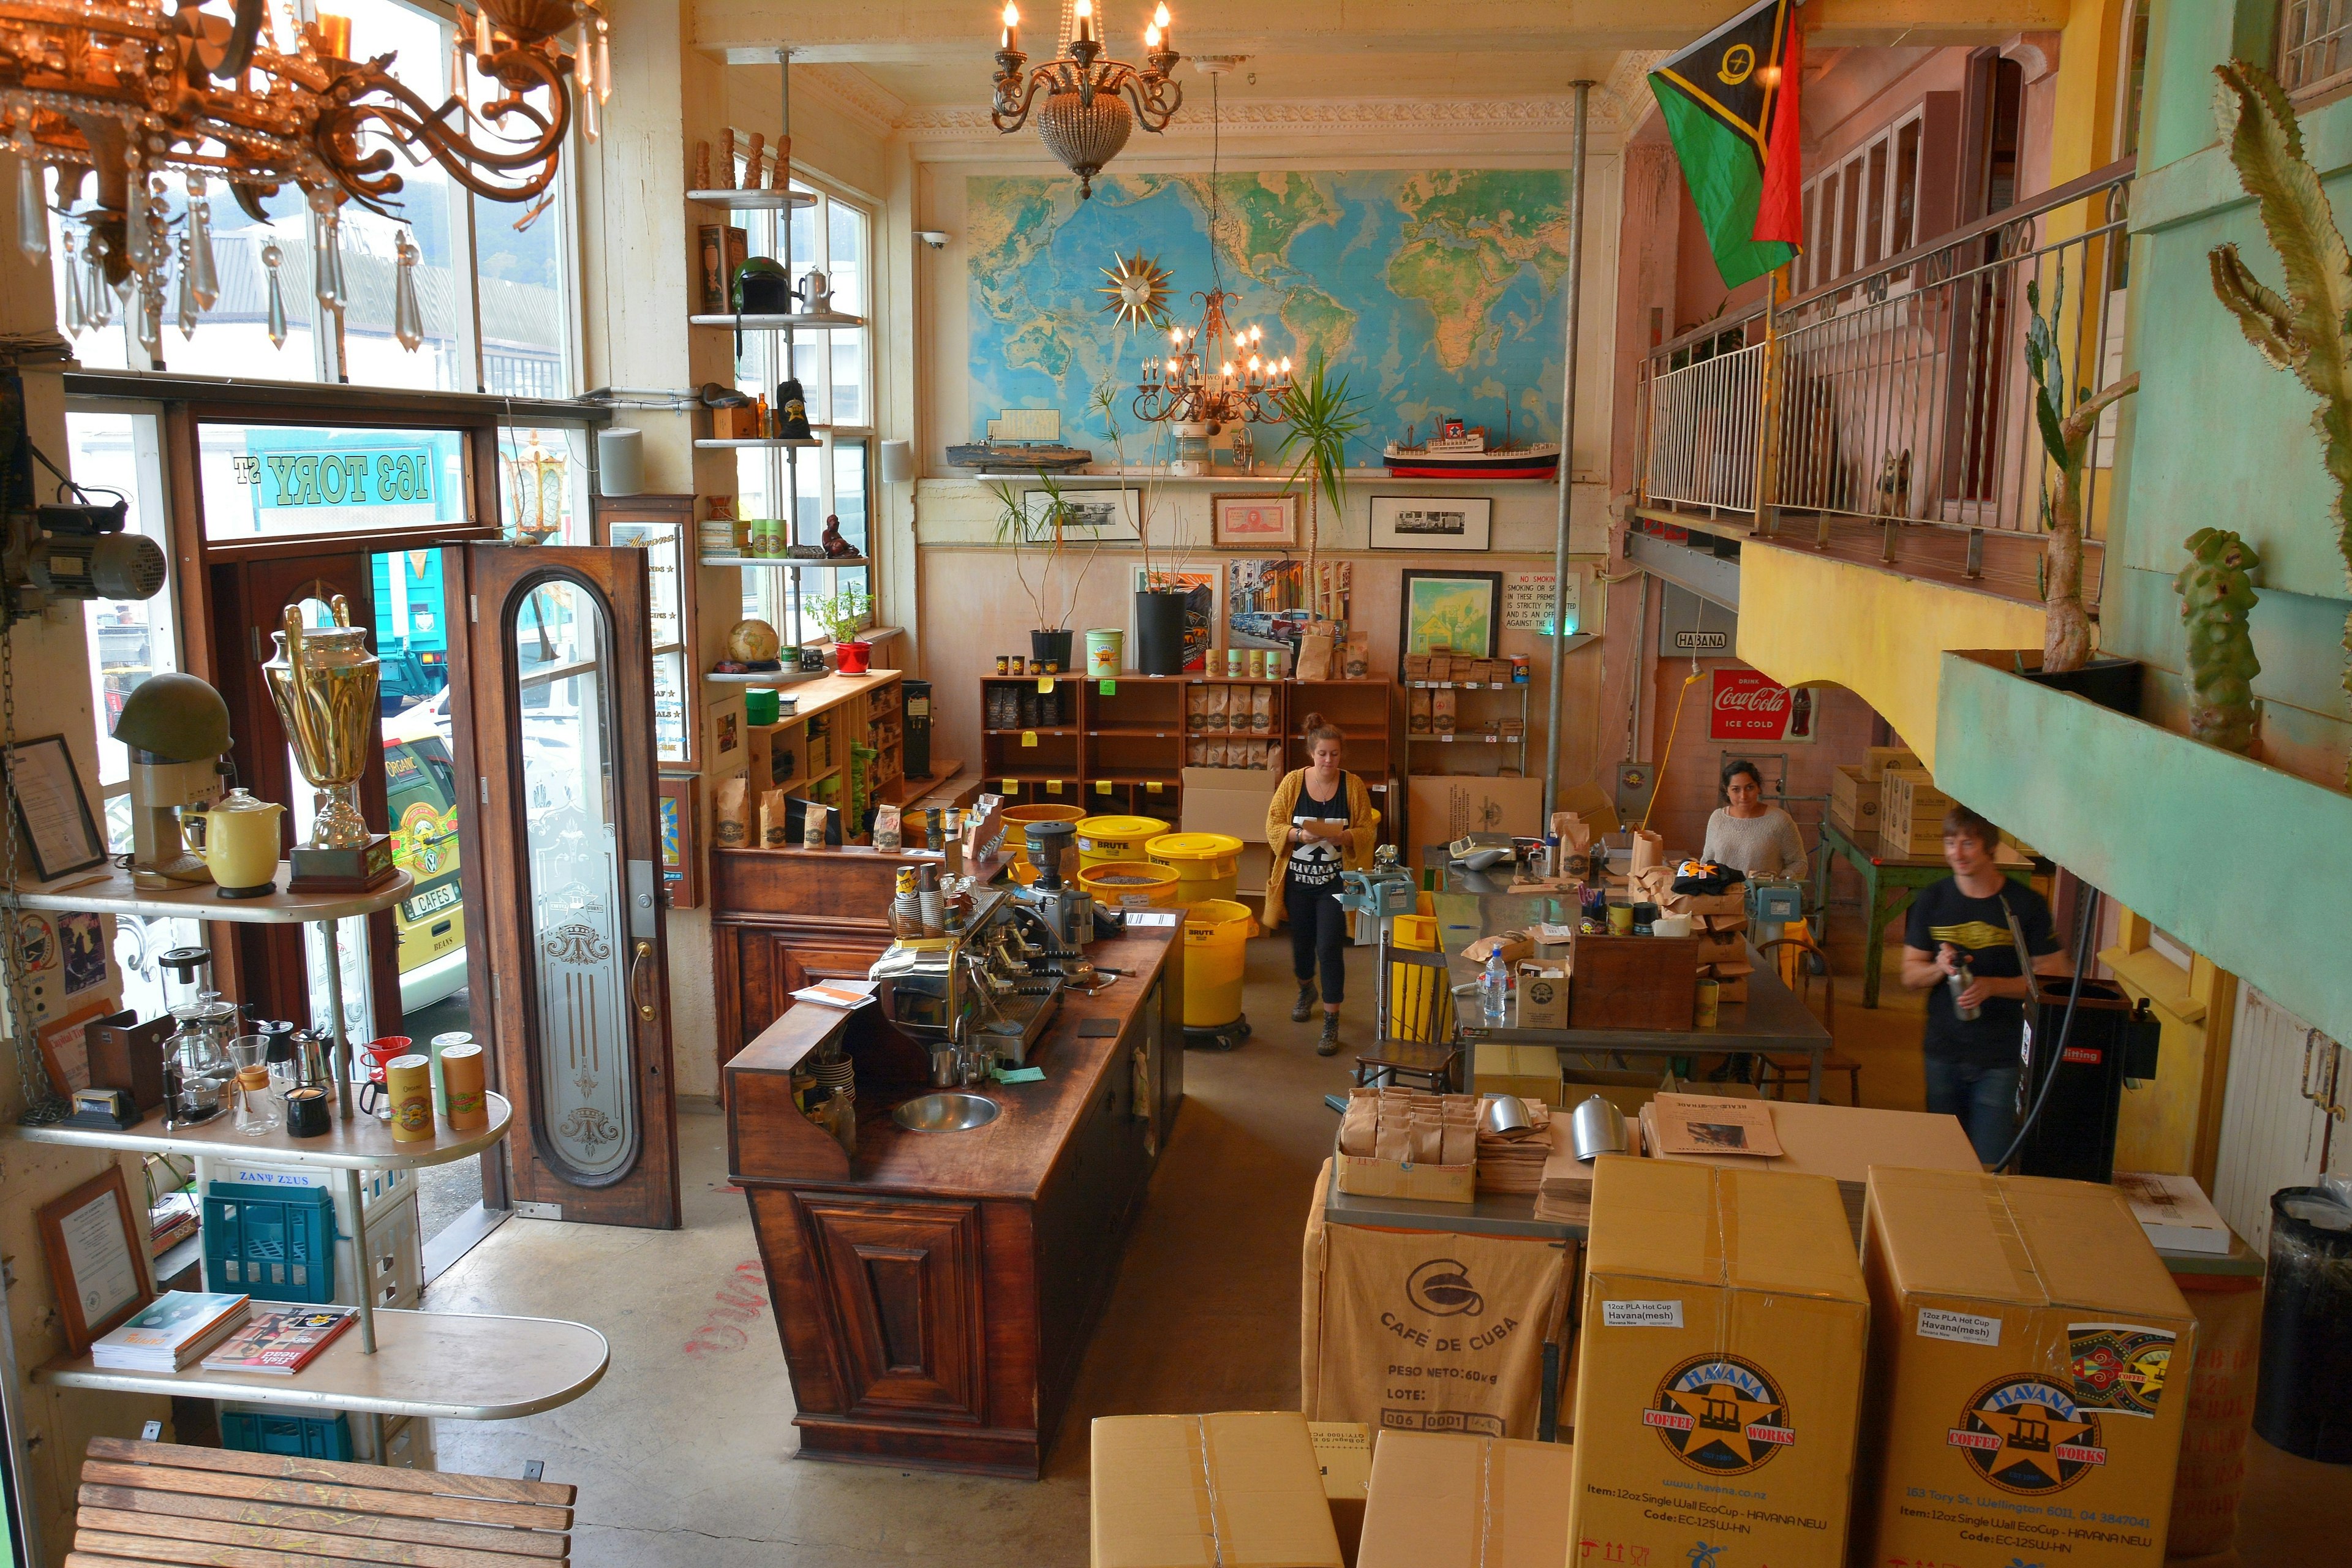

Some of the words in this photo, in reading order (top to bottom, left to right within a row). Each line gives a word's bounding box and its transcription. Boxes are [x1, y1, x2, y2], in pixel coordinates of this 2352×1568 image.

[1679, 635, 1724, 647] HABANA
[1714, 687, 1789, 712] Coca-Cola
[385, 757, 417, 777] ORGANIC
[1097, 841, 1129, 850] BRUTE
[1289, 861, 1343, 875] HAVANA'S
[418, 888, 450, 911] CAFES
[434, 937, 453, 951] BEANS
[173, 1224, 194, 1239] BOOK
[1609, 1312, 1673, 1321] Havana(mesh)
[1974, 1319, 1989, 1327] Cup
[1436, 1338, 1461, 1351] DE
[1469, 1317, 1518, 1351] CUBA
[1922, 1320, 1989, 1338] Havana(mesh)
[262, 1349, 301, 1360] head
[263, 1355, 294, 1365] fish
[1389, 1365, 1422, 1376] PESO
[1684, 1365, 1764, 1400] HAVANA
[1387, 1389, 1426, 1401] LOTE:
[1992, 1385, 2077, 1420] HAVANA
[1386, 1414, 1414, 1426] 006
[1427, 1417, 1461, 1427] 0001
[1646, 1412, 1693, 1430] COFFEE
[1749, 1427, 1795, 1444] WORKS
[1950, 1433, 1999, 1450] COFFEE
[2057, 1446, 2105, 1463] WORKS
[1662, 1479, 1767, 1500] www.havana.co.nz
[1587, 1483, 1616, 1497] Item:
[1617, 1488, 1641, 1502] 12oz
[1642, 1493, 1672, 1508] Single
[1673, 1498, 1697, 1510] Wall
[1699, 1502, 1738, 1517] EcoCup
[1747, 1510, 1796, 1526] HAVANA
[1797, 1517, 1827, 1530] NEW
[1906, 1487, 1925, 1498] 163
[1929, 1490, 1953, 1504] Tory
[1977, 1497, 2043, 1514] Wellington
[2079, 1510, 2096, 1521] 04
[2099, 1513, 2150, 1529] 3847041
[1644, 1509, 1677, 1523] Code:
[1678, 1515, 1751, 1534] EC-12SW-HN
[1900, 1506, 1931, 1518] Item:
[1931, 1510, 1957, 1523] 12oz
[1958, 1513, 1989, 1528] Single
[1991, 1518, 2016, 1531] Wall
[2018, 1521, 2059, 1536] EcoCup
[2068, 1528, 2119, 1544] HAVANA
[2120, 1535, 2152, 1548] NEW
[1960, 1530, 1994, 1544] Code:
[1996, 1535, 2071, 1554] EC-12SW-HN
